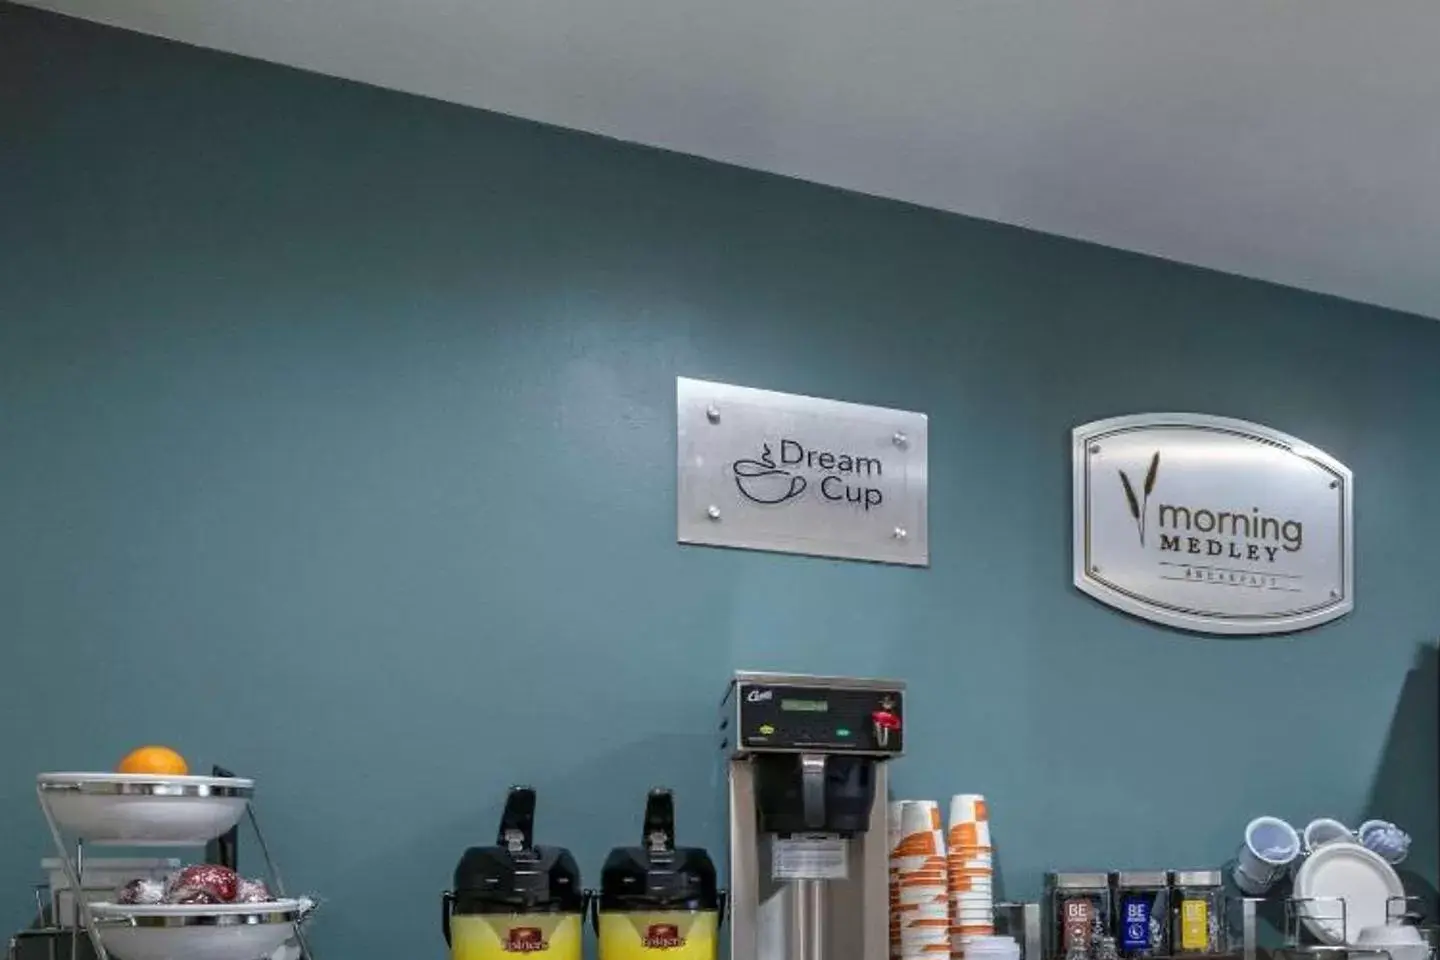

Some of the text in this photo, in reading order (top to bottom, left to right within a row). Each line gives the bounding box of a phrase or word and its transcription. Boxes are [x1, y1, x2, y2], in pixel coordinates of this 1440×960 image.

[781, 439, 882, 476] Dream
[821, 475, 883, 511] Cup
[1158, 504, 1303, 552] morning
[1160, 534, 1278, 562] MEDLEY
[1068, 903, 1088, 917] BE
[1127, 903, 1145, 917] BE
